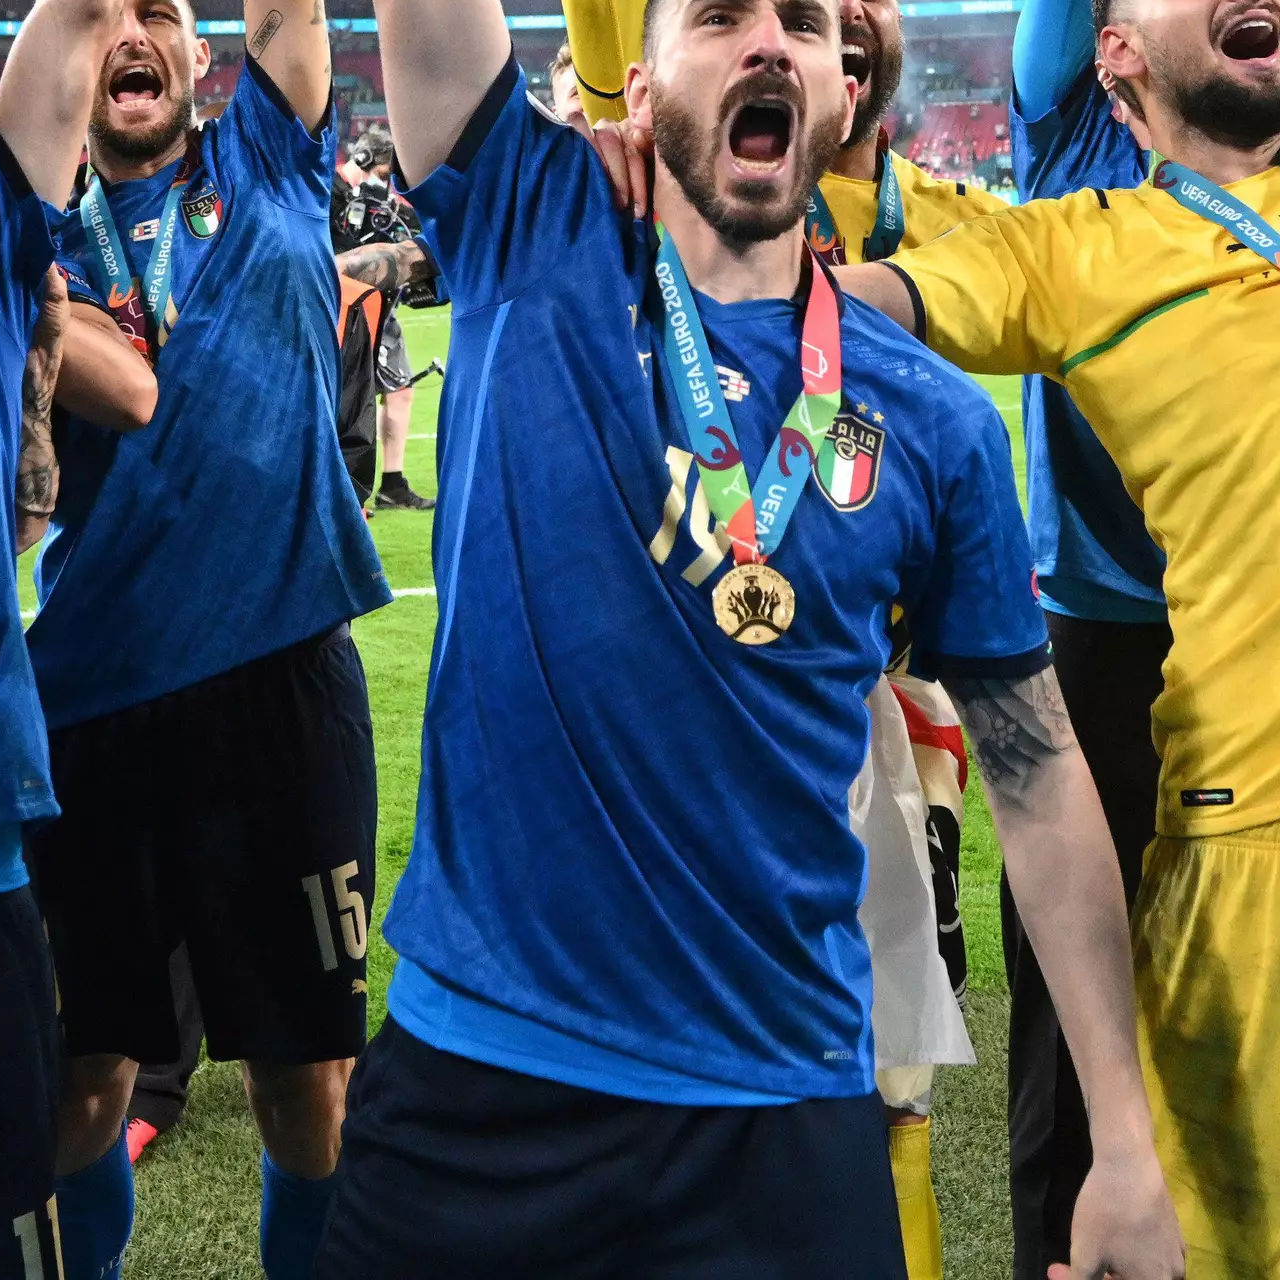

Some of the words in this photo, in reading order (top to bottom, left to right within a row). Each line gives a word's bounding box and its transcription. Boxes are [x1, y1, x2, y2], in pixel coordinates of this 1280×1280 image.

[884, 204, 896, 230] UEFA
[1181, 181, 1211, 207] UEFA
[1208, 199, 1243, 221] EURO
[1236, 219, 1274, 248] 2020
[91, 215, 110, 246] EURO
[101, 245, 120, 277] 2020
[154, 239, 172, 276] EURO
[147, 278, 164, 312] UEFA
[655, 261, 683, 313] 2020
[670, 310, 699, 366] EURO
[687, 363, 714, 419] UEFA
[829, 421, 876, 449] TALIA
[755, 484, 787, 536] UEFA
[301, 859, 367, 972] 15
